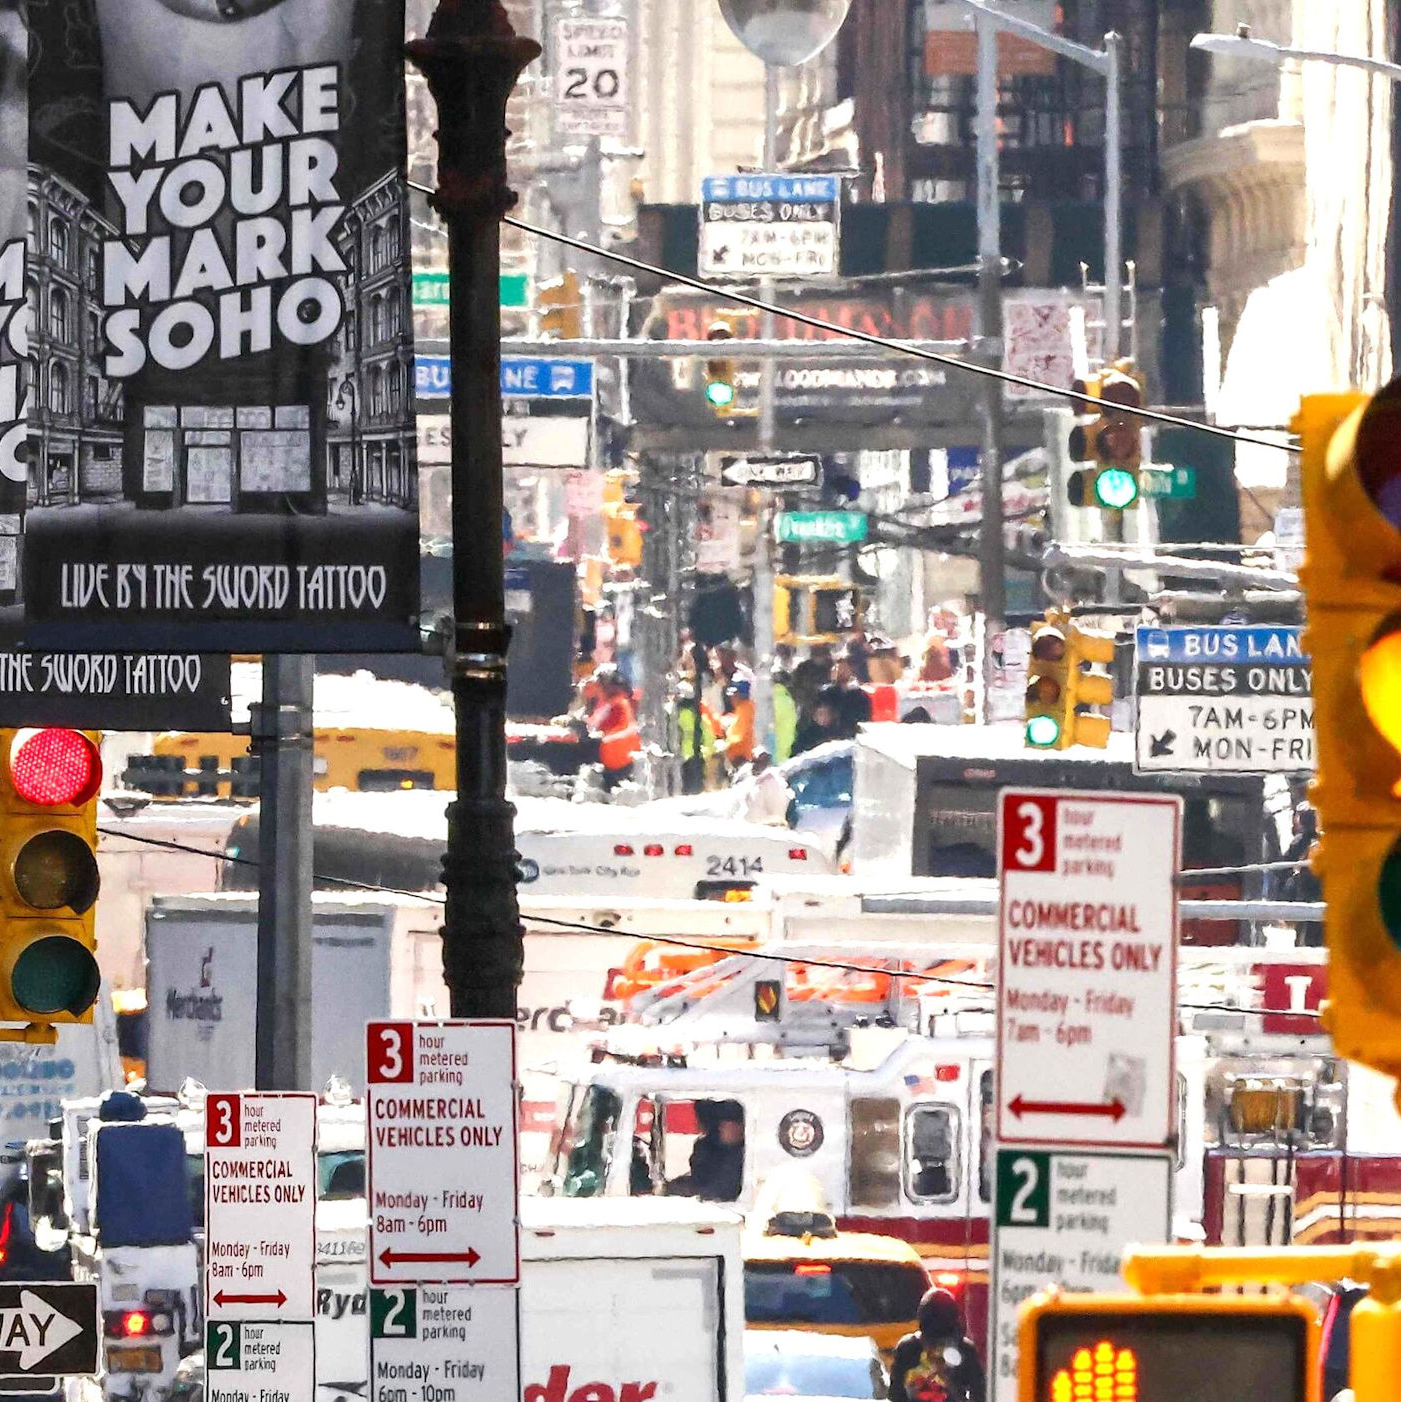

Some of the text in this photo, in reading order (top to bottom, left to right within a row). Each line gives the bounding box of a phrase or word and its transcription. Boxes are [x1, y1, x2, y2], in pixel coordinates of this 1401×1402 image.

[565, 68, 618, 98] 20
[109, 64, 339, 169] MAKE
[109, 139, 338, 236] YOUR
[736, 178, 773, 198] BUS
[103, 203, 347, 306] MARK
[104, 278, 342, 378] SOHO
[416, 365, 449, 388] BU
[61, 562, 386, 610] LIVE BY THE SWORD TATTOO
[1184, 633, 1302, 657] BUS LAN
[0, 652, 35, 692] THE
[40, 653, 117, 693] SWORD
[125, 654, 201, 694] TATTOO
[1149, 667, 1313, 692] BUSES ONLY
[1188, 705, 1315, 731] 7AM-6PM
[1194, 737, 1312, 760] MON-FRI
[1015, 800, 1045, 868] 3
[706, 854, 764, 876] 2414
[1008, 900, 1142, 934] COMMERCIAL
[1008, 940, 1162, 971] VEHICLES ONLY
[1007, 988, 1069, 1016] Monday
[419, 1034, 445, 1049] hour
[379, 1029, 404, 1079] 3
[419, 1051, 468, 1067] metered
[419, 1069, 463, 1086] parking
[244, 1104, 265, 1117] hour
[375, 1099, 485, 1120] COMMERCIAL
[216, 1100, 234, 1144] 3
[244, 1119, 282, 1133] metered
[244, 1135, 277, 1150] parking
[375, 1126, 503, 1148] VEHICLES ONLY
[212, 1160, 293, 1180] COMMERCIAL
[212, 1184, 306, 1204] VEHICLES ONLY
[1009, 1157, 1039, 1223] 2
[376, 1191, 484, 1212] Monday Friday
[376, 1216, 448, 1236] 8am 6pm
[211, 1240, 290, 1259] Monday Friday
[212, 1262, 263, 1280] 8am 6pm
[317, 1288, 367, 1320] Ryd
[422, 1290, 448, 1304] hour
[383, 1289, 407, 1335] 2
[422, 1306, 471, 1322] metered
[244, 1326, 265, 1341] hour
[422, 1325, 466, 1342] parking
[216, 1324, 234, 1367] 2
[244, 1342, 281, 1356] metered
[244, 1358, 276, 1373] parking
[378, 1360, 485, 1381] Monday Friday
